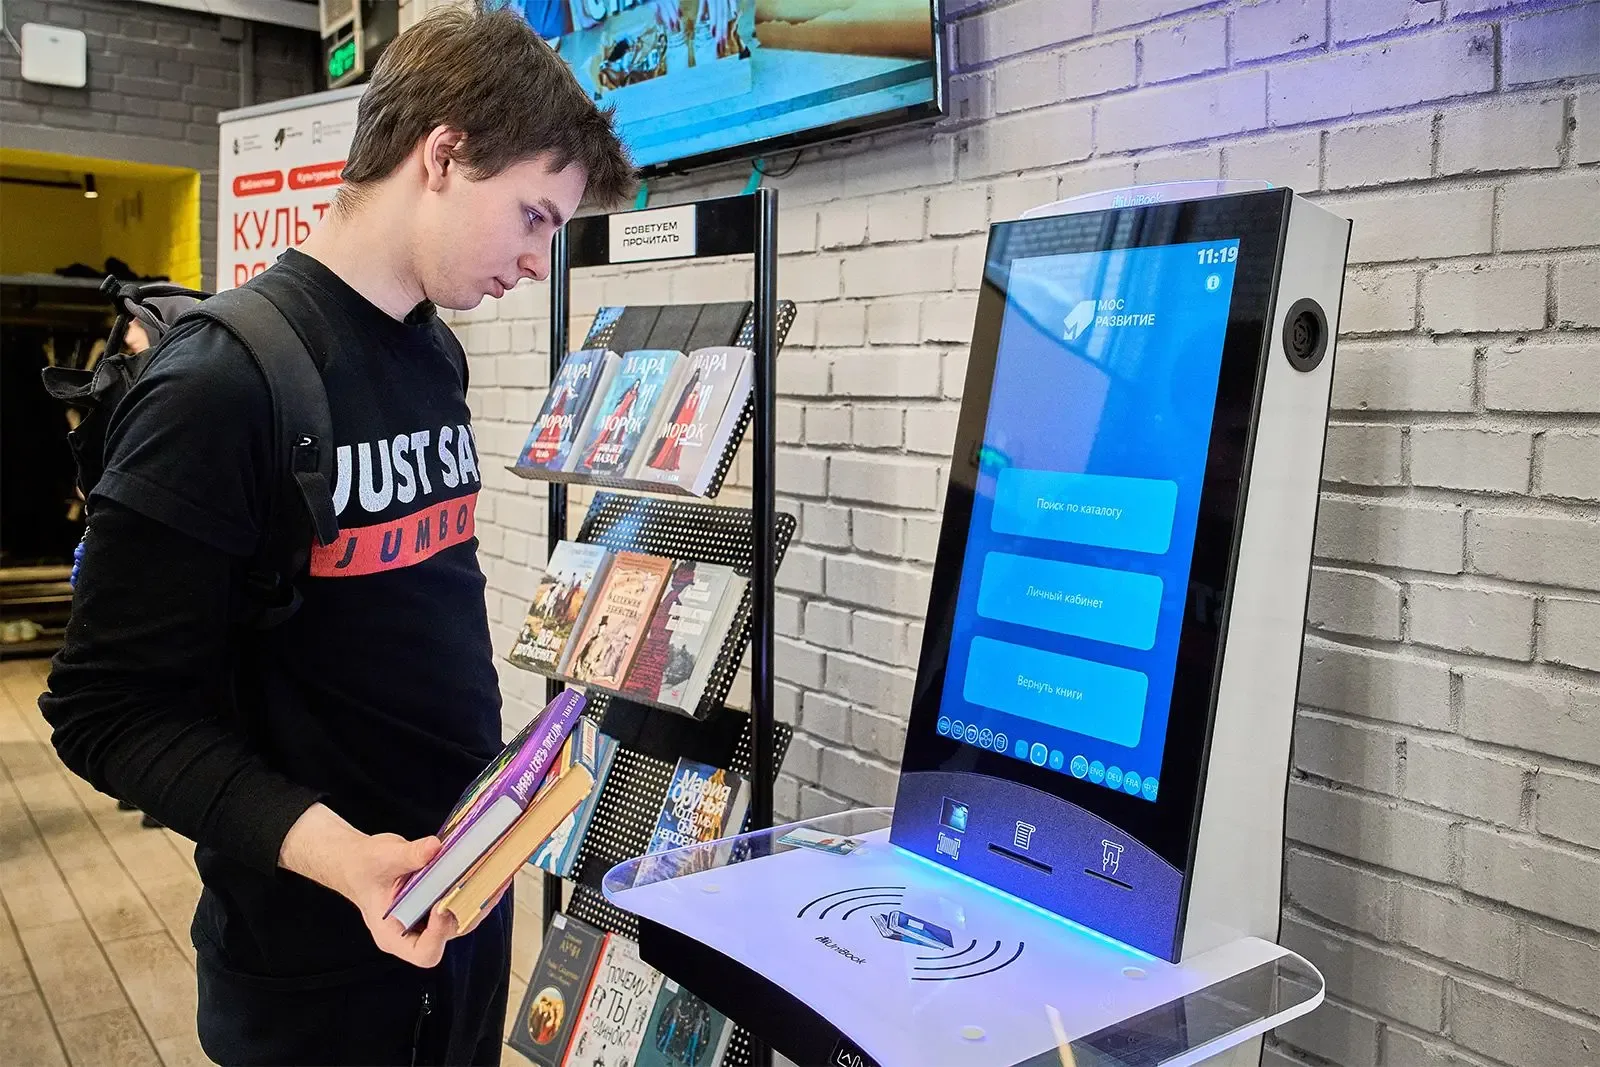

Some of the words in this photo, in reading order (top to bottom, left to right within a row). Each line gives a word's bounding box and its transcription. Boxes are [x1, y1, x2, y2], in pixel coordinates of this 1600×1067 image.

[234, 203, 330, 252] КУЛЬТ
[624, 221, 678, 235] СОВЕТУЕМ
[622, 234, 680, 247] ПРОЧИТАТЬ
[1197, 246, 1239, 265] 11:19
[1097, 298, 1125, 311] МОС
[1095, 313, 1156, 329] РАЗВИТИЕ
[624, 356, 666, 384] МАРА
[690, 352, 727, 381] МАРА
[540, 414, 577, 436] МОРОК
[597, 415, 647, 441] МОРОК
[659, 422, 708, 448] МОРОК
[332, 430, 433, 517] JUST
[438, 424, 480, 488] SA
[1036, 497, 1064, 513] Поиск
[1066, 501, 1079, 513] по
[1081, 502, 1123, 520] каталогу
[335, 504, 468, 569] JUMBO
[1026, 584, 1063, 602] Личный
[1064, 592, 1104, 609] кабинет
[1017, 673, 1054, 696] Вернуть
[1055, 684, 1084, 701] книги
[1073, 761, 1086, 772] РУС
[1090, 766, 1104, 777] ENG
[1107, 771, 1121, 783] DEU
[681, 769, 731, 801] Мария
[1125, 777, 1139, 788] FRA
[672, 784, 727, 817] Орунья
[672, 802, 700, 824] Когда
[677, 817, 703, 841] были
[606, 966, 649, 998] ПОЧЕМУ
[606, 988, 633, 1026] ТЫ
[592, 1015, 631, 1049] ОДИНОК?
